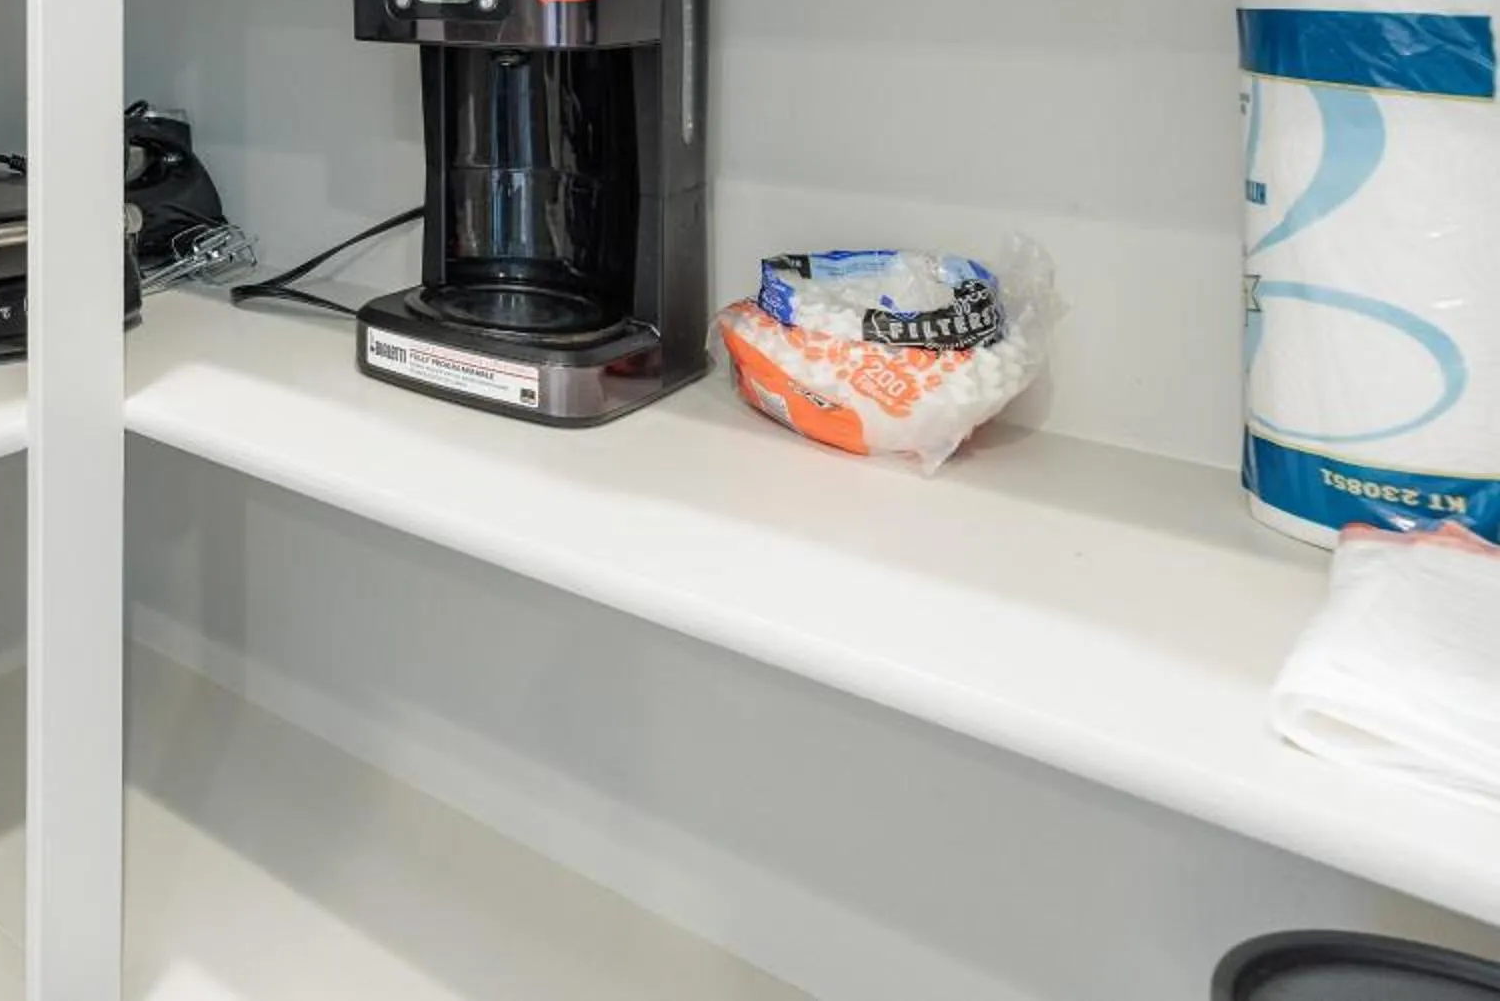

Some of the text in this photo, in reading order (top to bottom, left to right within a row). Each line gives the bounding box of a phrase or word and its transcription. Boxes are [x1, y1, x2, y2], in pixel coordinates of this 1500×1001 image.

[889, 307, 991, 340] FILTERS
[864, 361, 907, 396] 200
[1320, 468, 1467, 515] KT 230851
